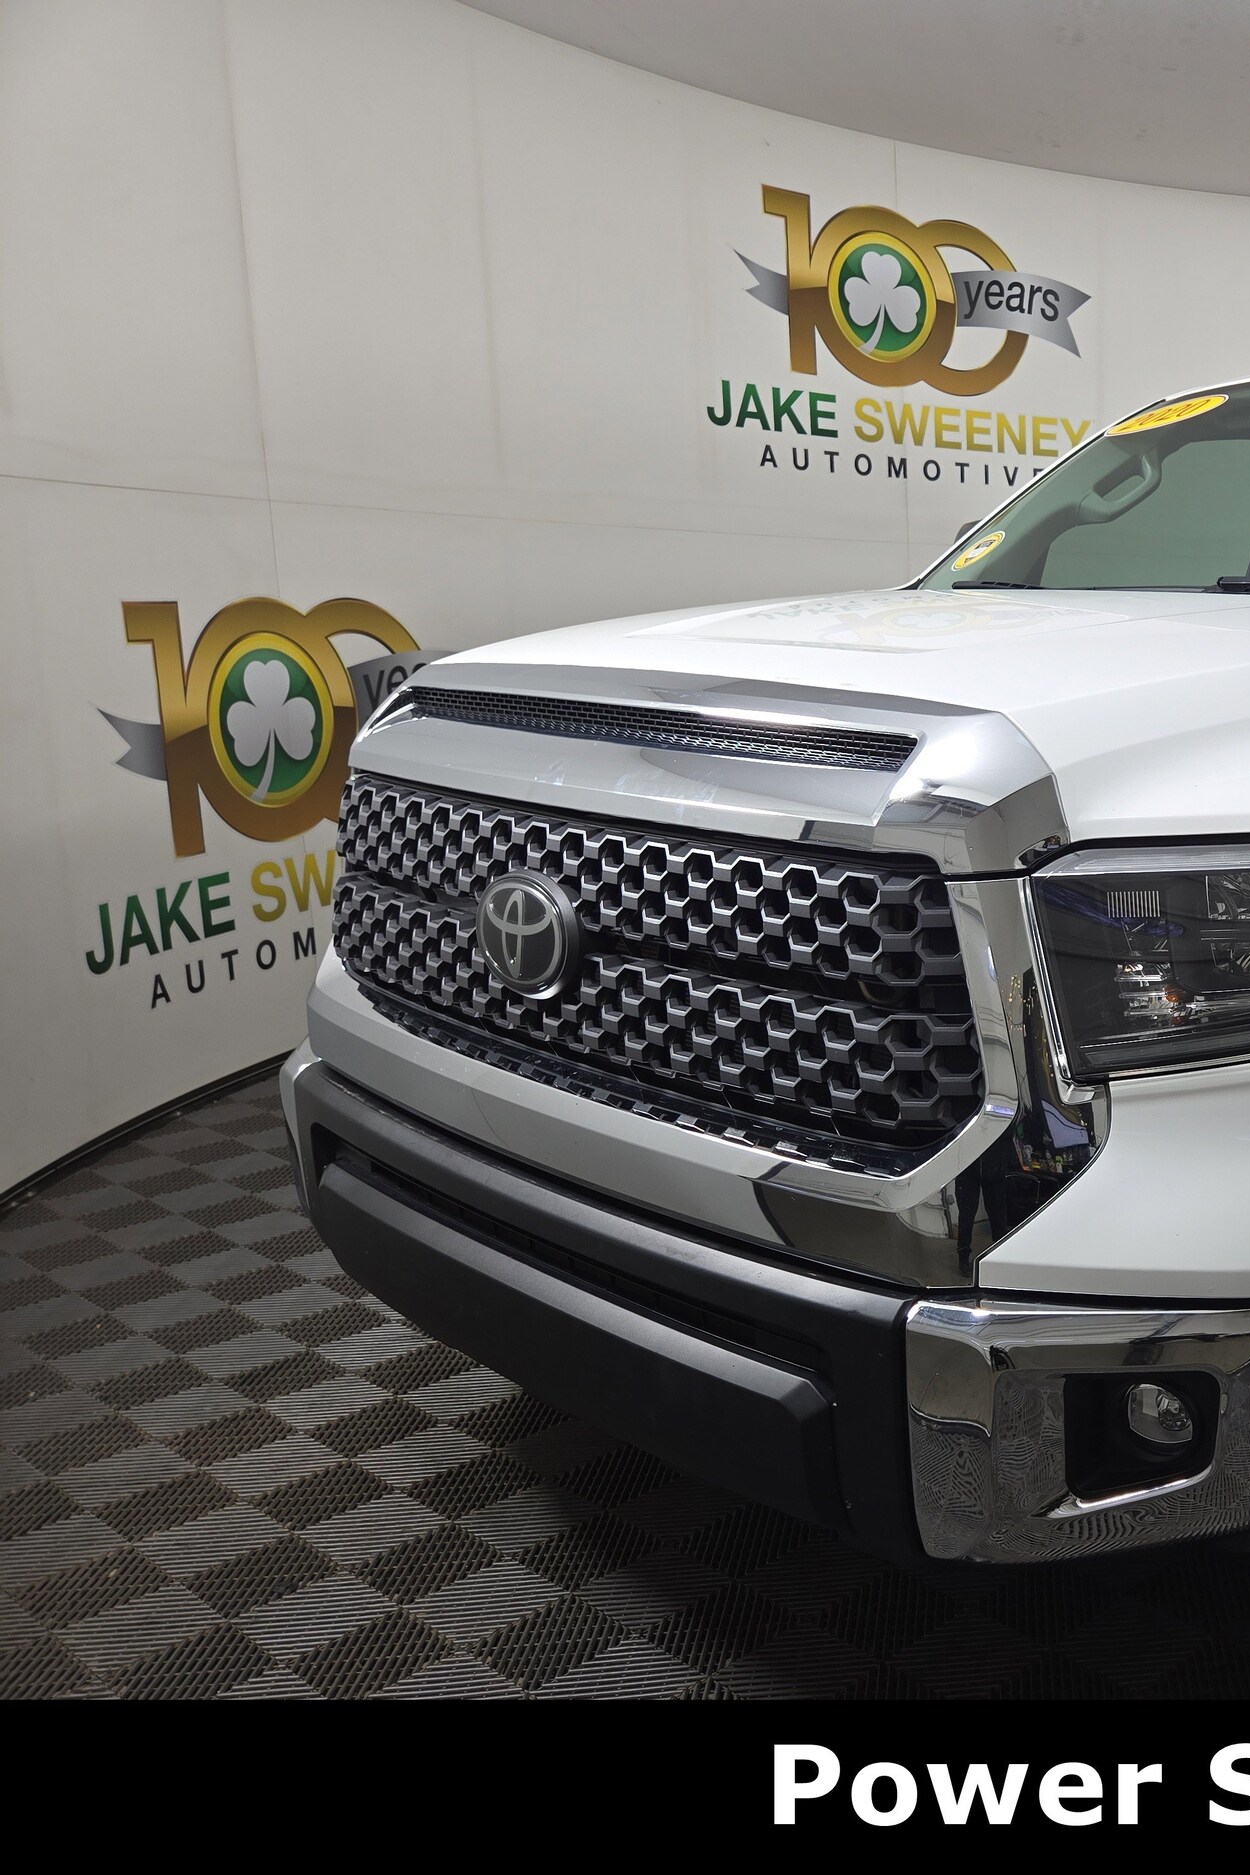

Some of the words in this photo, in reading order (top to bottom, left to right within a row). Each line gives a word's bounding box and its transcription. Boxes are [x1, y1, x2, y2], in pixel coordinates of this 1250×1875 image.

[761, 184, 1029, 397] 100
[963, 279, 1060, 322] years
[706, 379, 840, 438] JAKE
[854, 397, 1092, 458] SWEENEY
[362, 662, 427, 719] ye
[85, 870, 236, 976] JAKE
